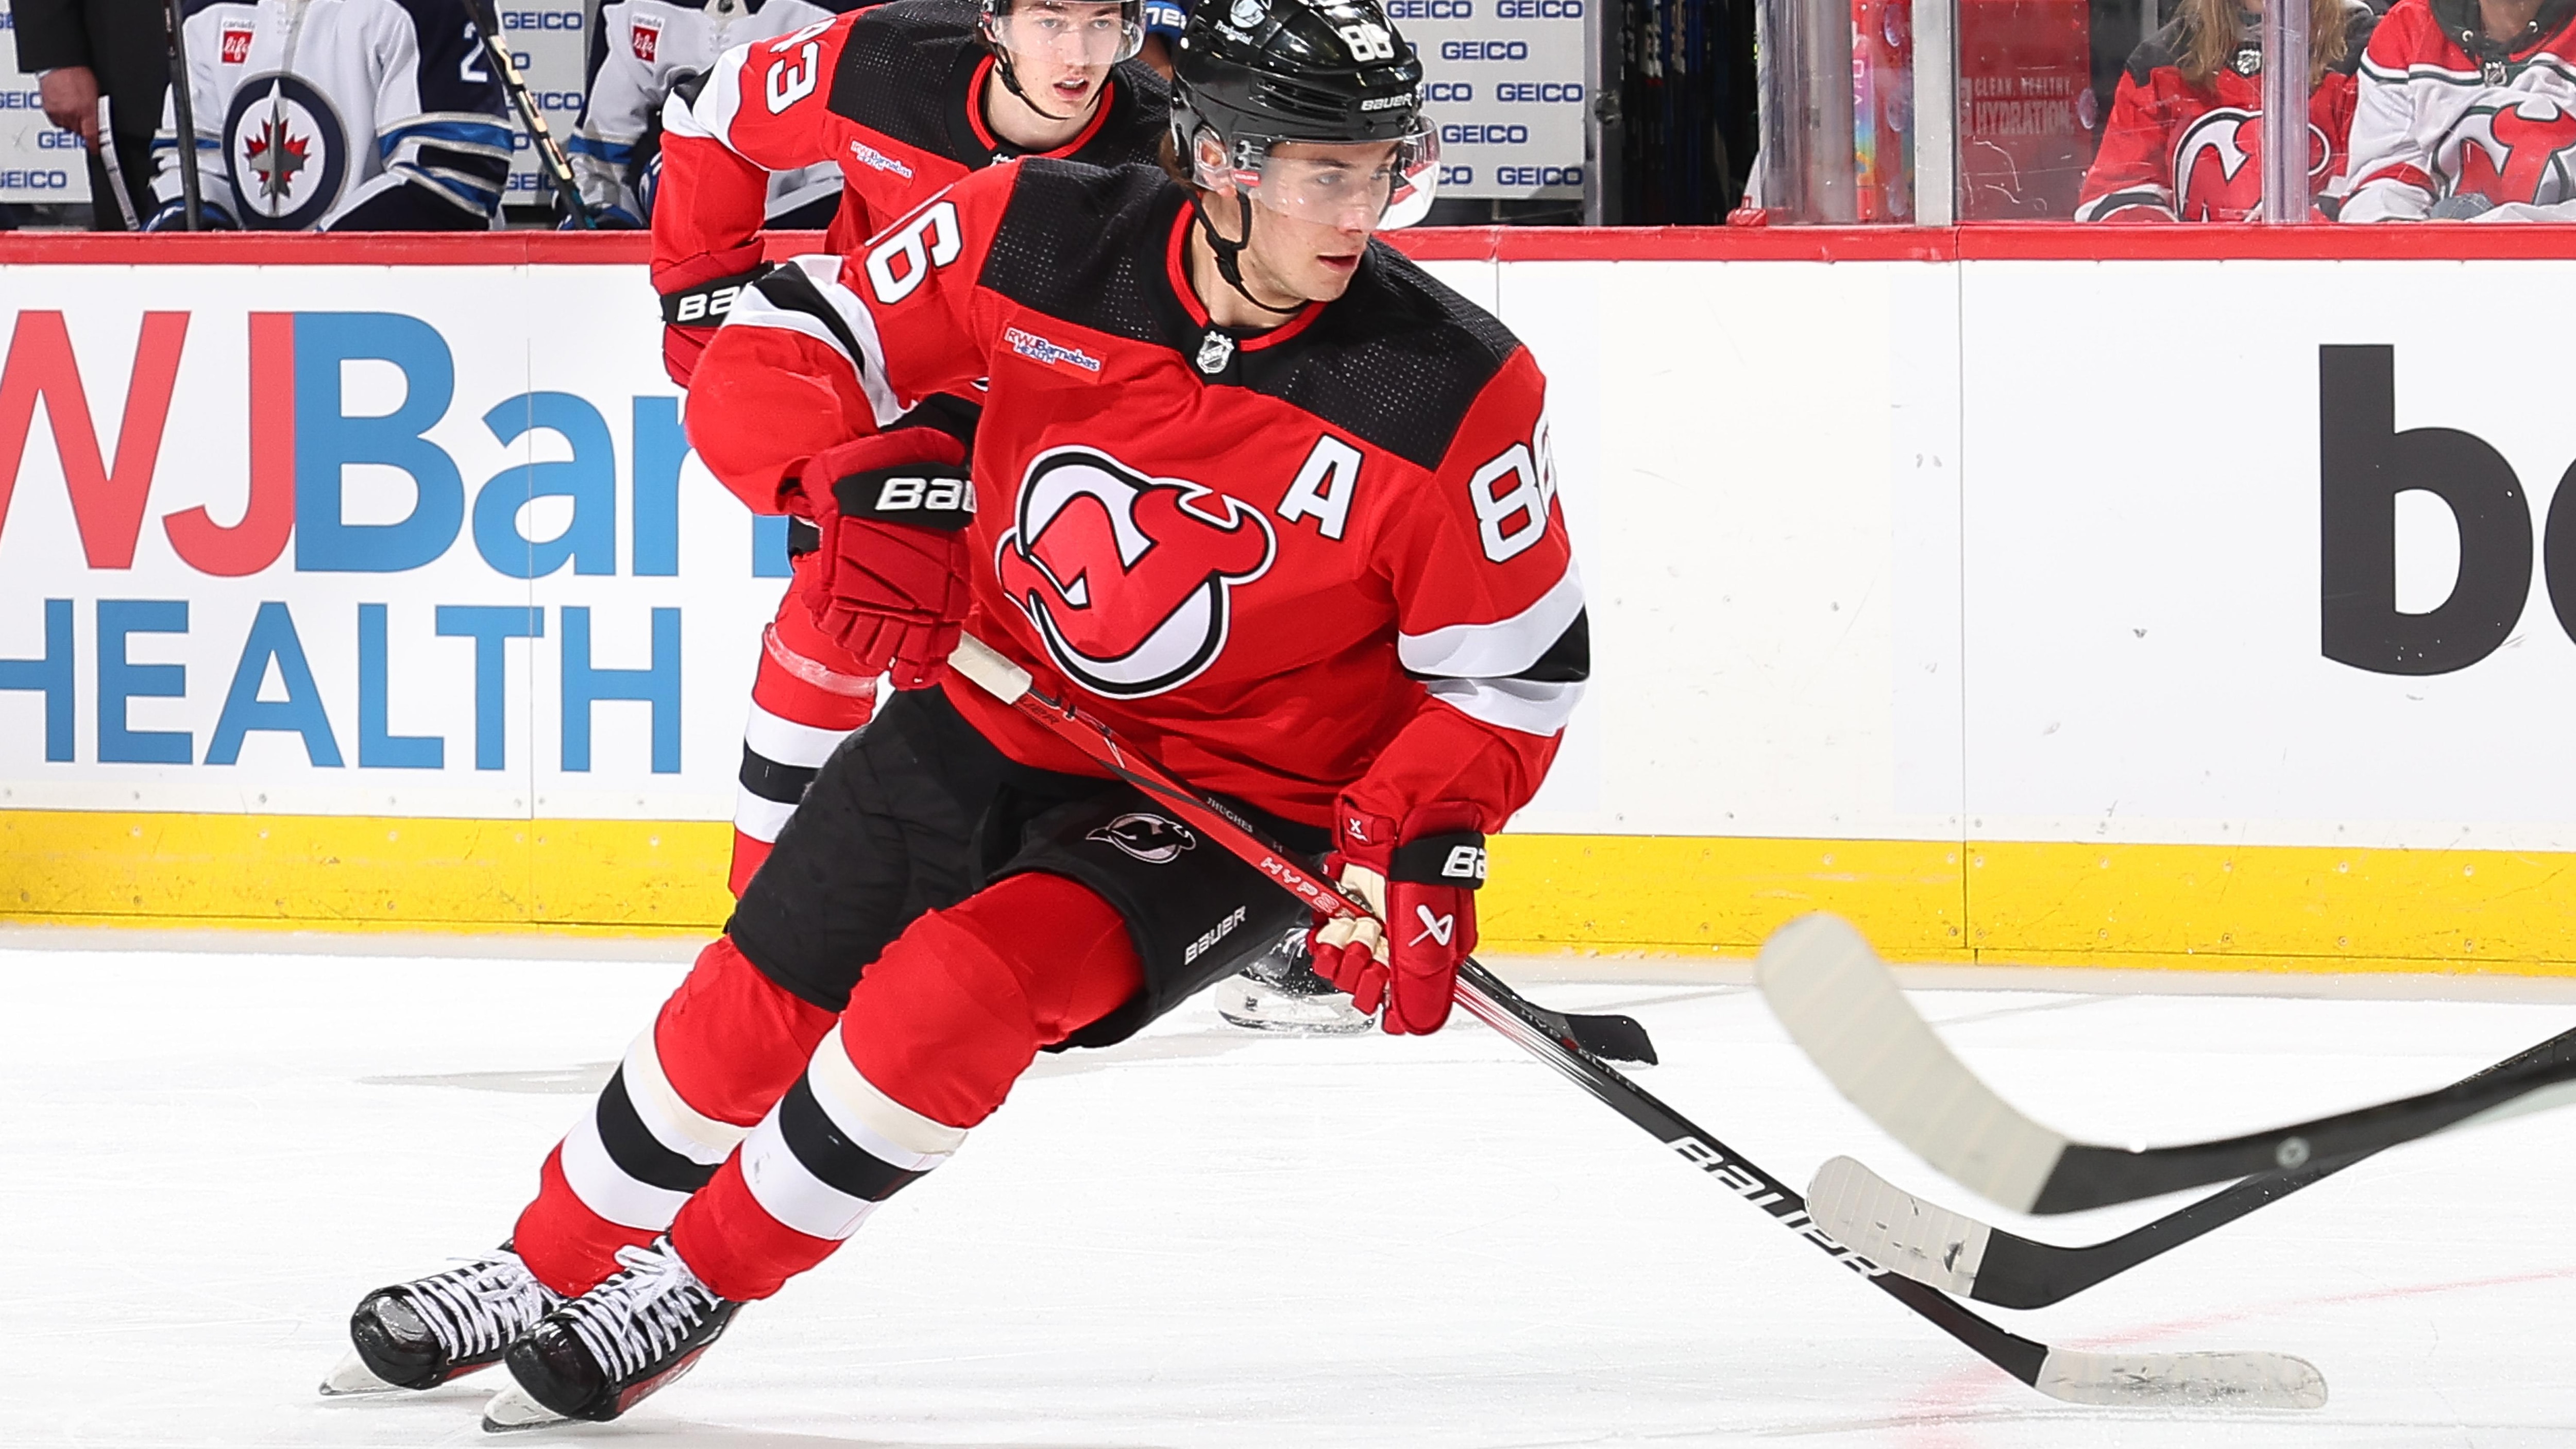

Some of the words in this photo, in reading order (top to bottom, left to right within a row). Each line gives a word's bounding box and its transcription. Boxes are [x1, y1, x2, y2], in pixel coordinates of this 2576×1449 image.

[1387, 1, 1472, 18] GEICO
[1497, 1, 1582, 18] GEICO
[502, 12, 583, 29] GEICO
[1340, 23, 1394, 62] 86
[1443, 42, 1528, 60] GEICO
[0, 92, 43, 109] EIC
[1423, 83, 1472, 101] ICO
[1497, 83, 1583, 101] GEICO
[1361, 93, 1412, 111] BAUER
[38, 132, 87, 149] GEI
[1443, 125, 1528, 143] GEICO
[0, 171, 67, 188] EICO
[1497, 167, 1583, 185] GEICO
[866, 183, 962, 304] 6
[1006, 329, 1097, 370] RWJBarnabas
[1016, 344, 1054, 363] HEALTH
[0, 310, 792, 579] WJBar
[1277, 434, 1364, 542] A
[2319, 344, 2576, 676] b
[0, 599, 682, 774] HEALTH
[1207, 797, 1253, 833] JHUGHES
[1184, 905, 1246, 966] BAUER
[1667, 1136, 1890, 1278] BAUER
